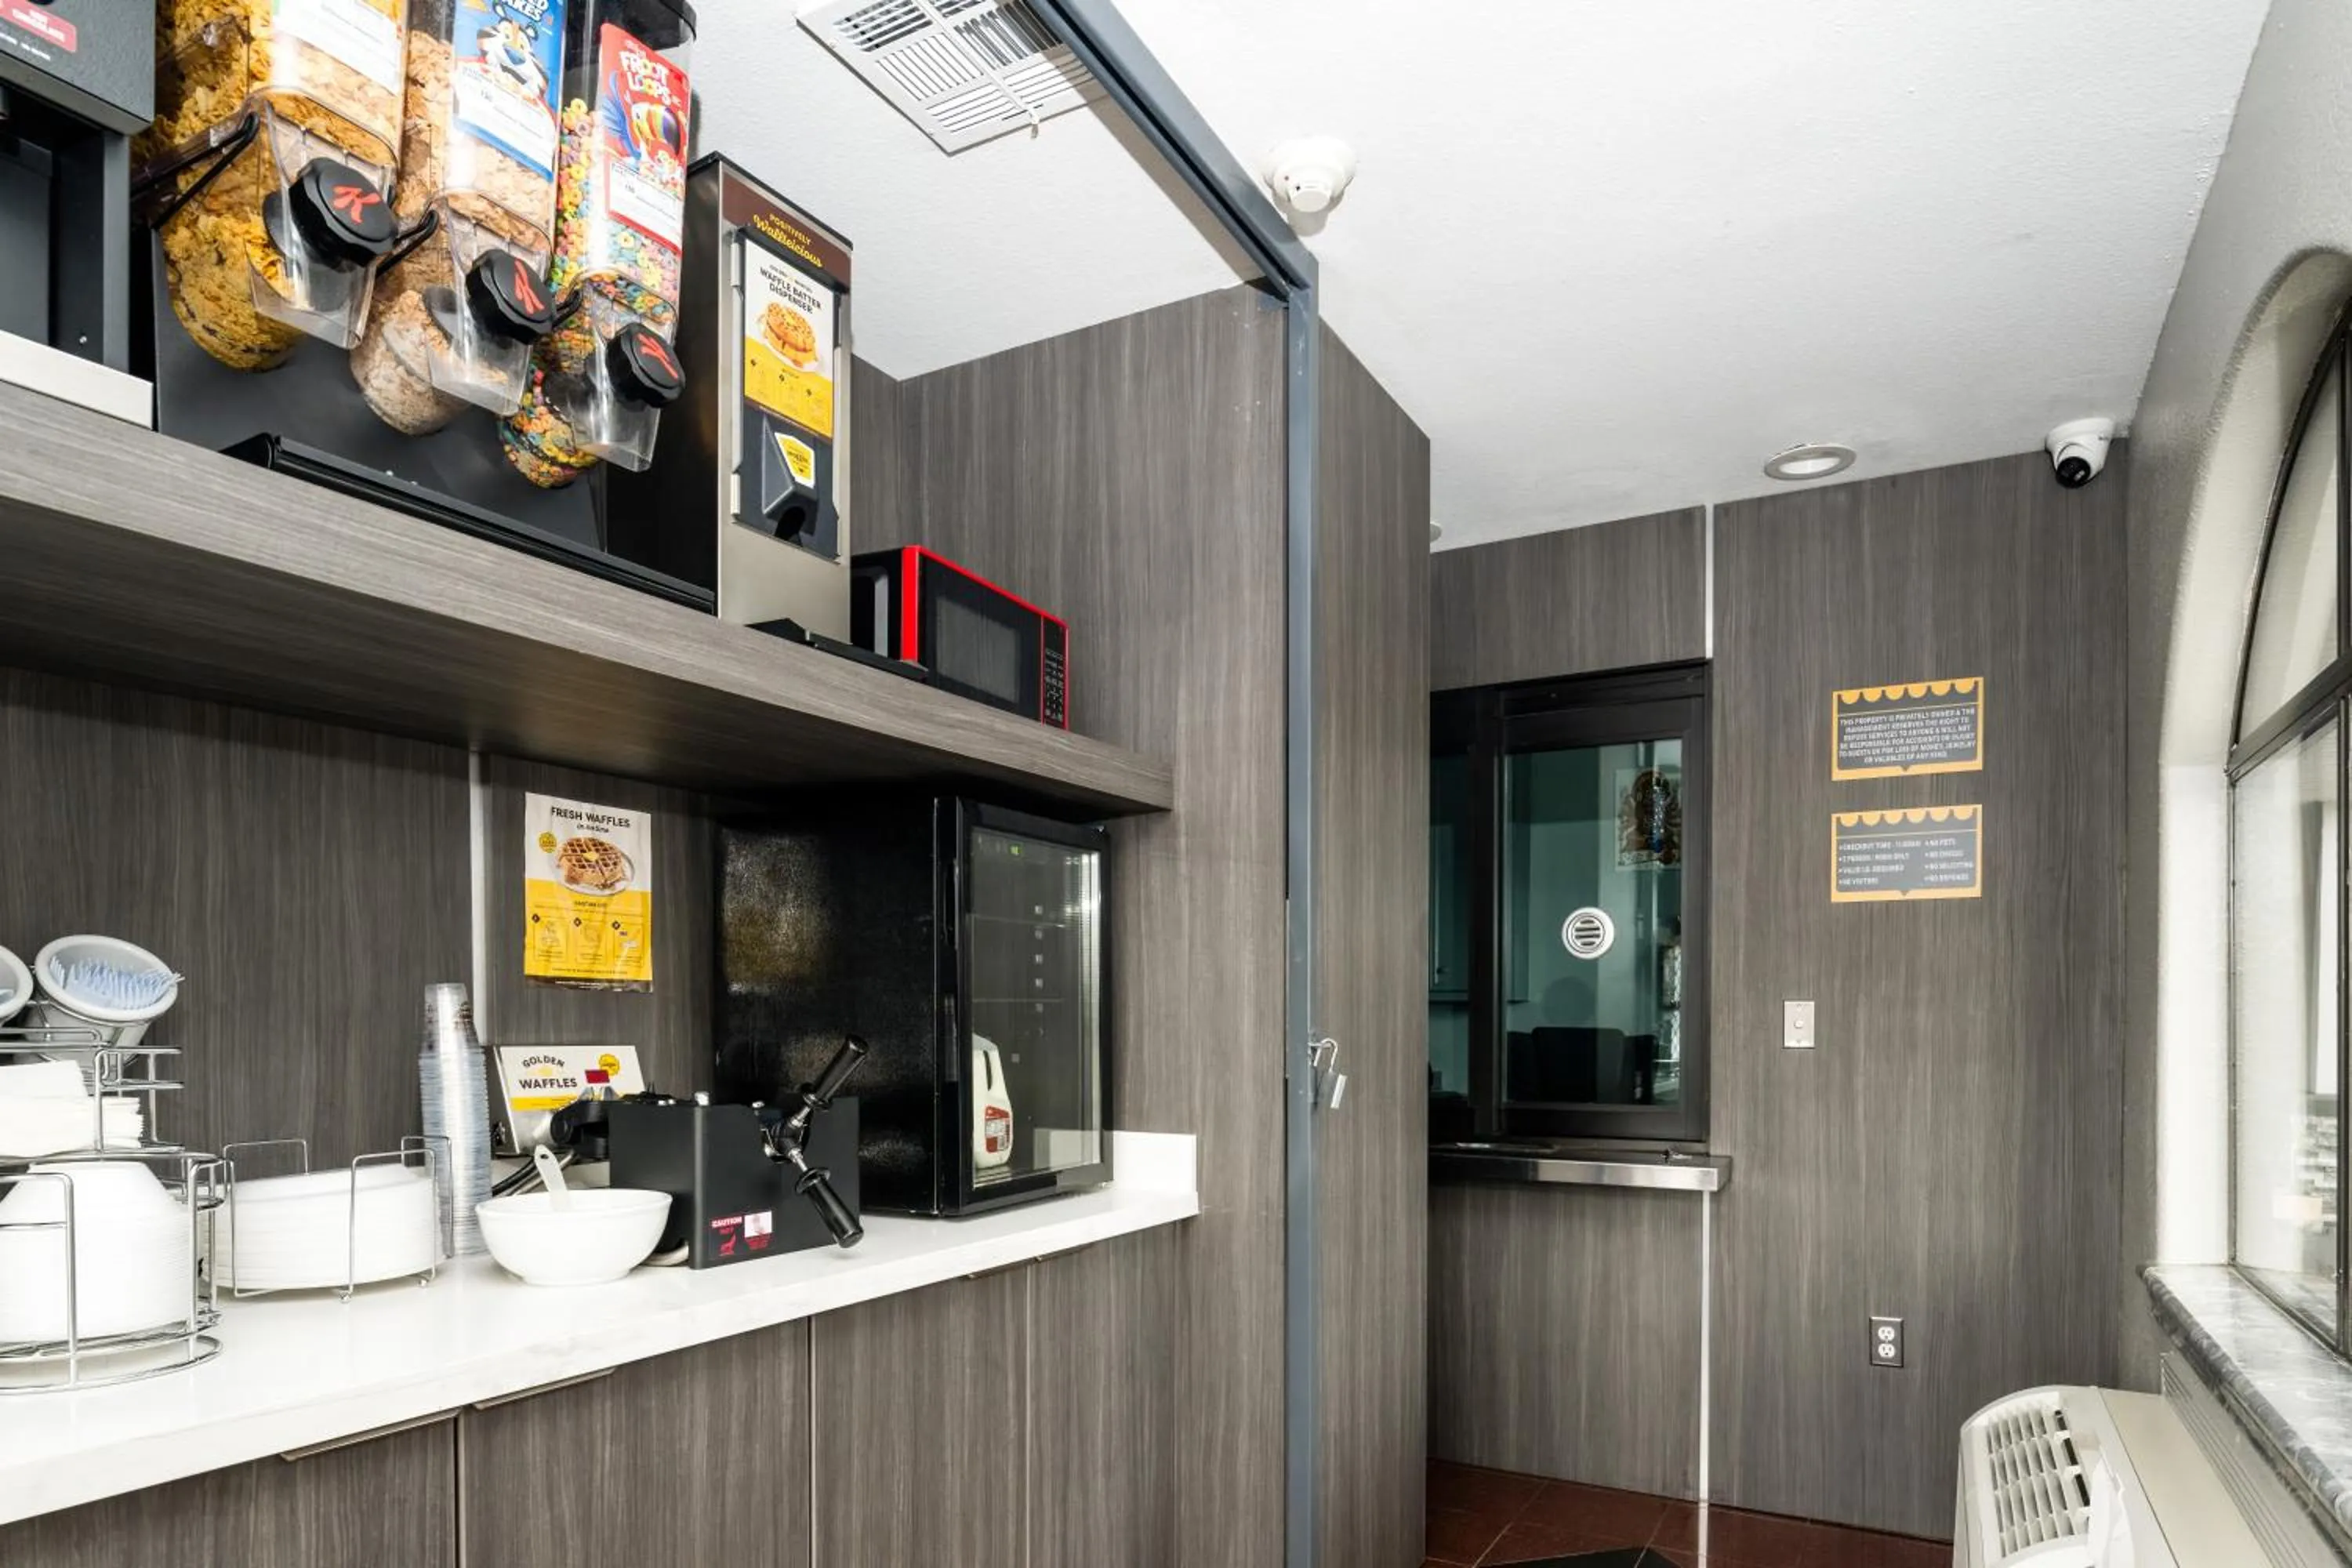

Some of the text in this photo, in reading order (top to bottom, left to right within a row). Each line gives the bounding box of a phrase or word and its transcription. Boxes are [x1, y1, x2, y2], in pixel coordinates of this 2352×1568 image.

[619, 51, 669, 84] FROOT
[626, 71, 671, 107] LOOPS
[769, 213, 812, 245] POSITIVELY
[760, 267, 792, 293] WAFFLE
[793, 286, 822, 310] BATTER
[769, 282, 814, 314] DISPENSER
[1854, 715, 1886, 724] PROPERTY
[1939, 717, 1960, 725] RIGHT
[1849, 739, 1889, 749] RESPONSIBLE
[1915, 751, 1928, 760] ANY
[551, 806, 630, 828] FRESH WAFFLES
[521, 1056, 564, 1068] GOLDEN
[519, 1078, 578, 1090] WAFFLES
[712, 1216, 742, 1229] CAUTION
